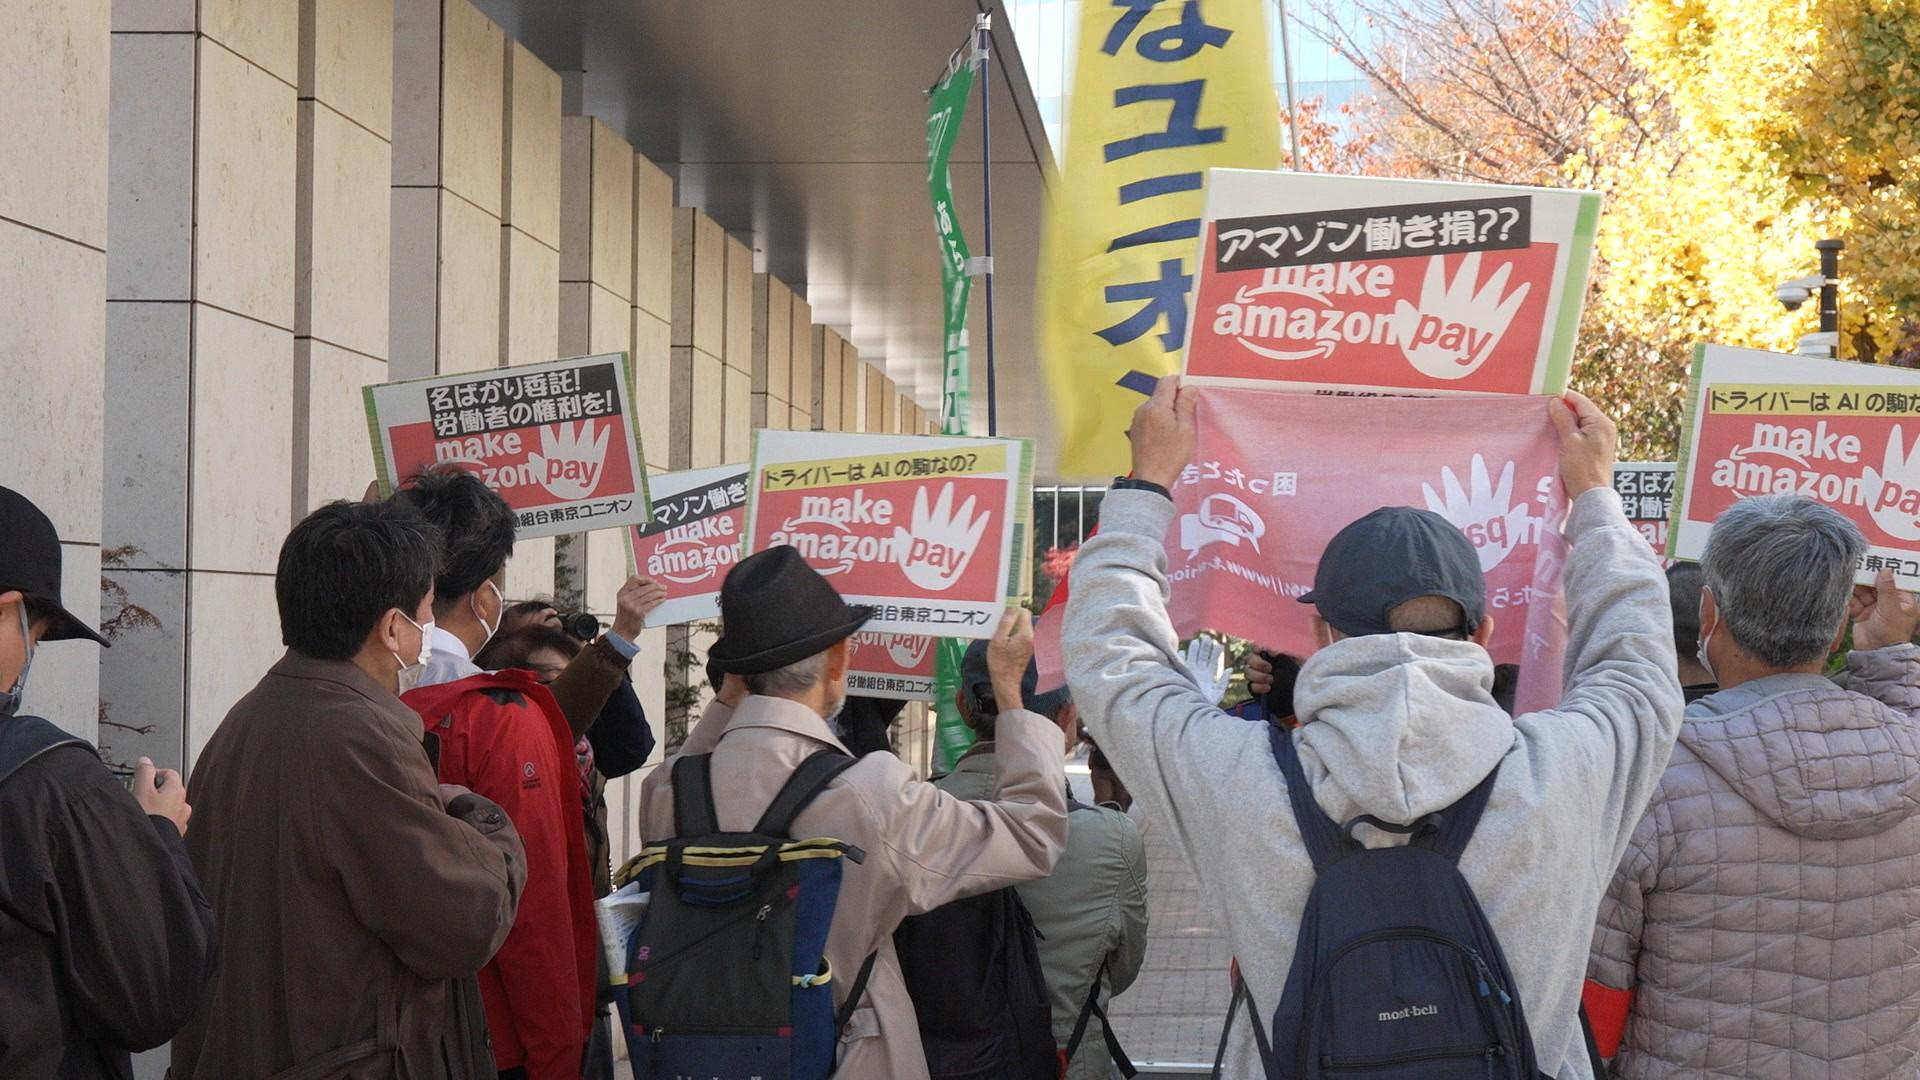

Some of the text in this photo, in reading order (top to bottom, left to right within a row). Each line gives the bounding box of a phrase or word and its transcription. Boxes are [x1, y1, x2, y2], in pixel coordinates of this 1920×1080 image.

[1091, 0, 1233, 440] なユニオ
[1219, 207, 1520, 264] アマゾン働き損??
[1261, 261, 1395, 298] make
[1213, 302, 1494, 366] amazon pay
[429, 368, 580, 411] 名ばかり委託!
[1711, 389, 1830, 412] ドライバーは
[1837, 392, 1859, 411] AI
[434, 389, 613, 437] 労働者の権利を!
[434, 432, 522, 464] make
[1752, 420, 1862, 464] make
[546, 456, 598, 488] pay
[764, 453, 977, 488] ドライバーは AI の駒なの?
[800, 488, 894, 525] make
[1711, 458, 1920, 529] amazon pa
[664, 515, 735, 543] make
[906, 537, 966, 579] pay
[848, 602, 991, 626] 組合東京ユニオン
